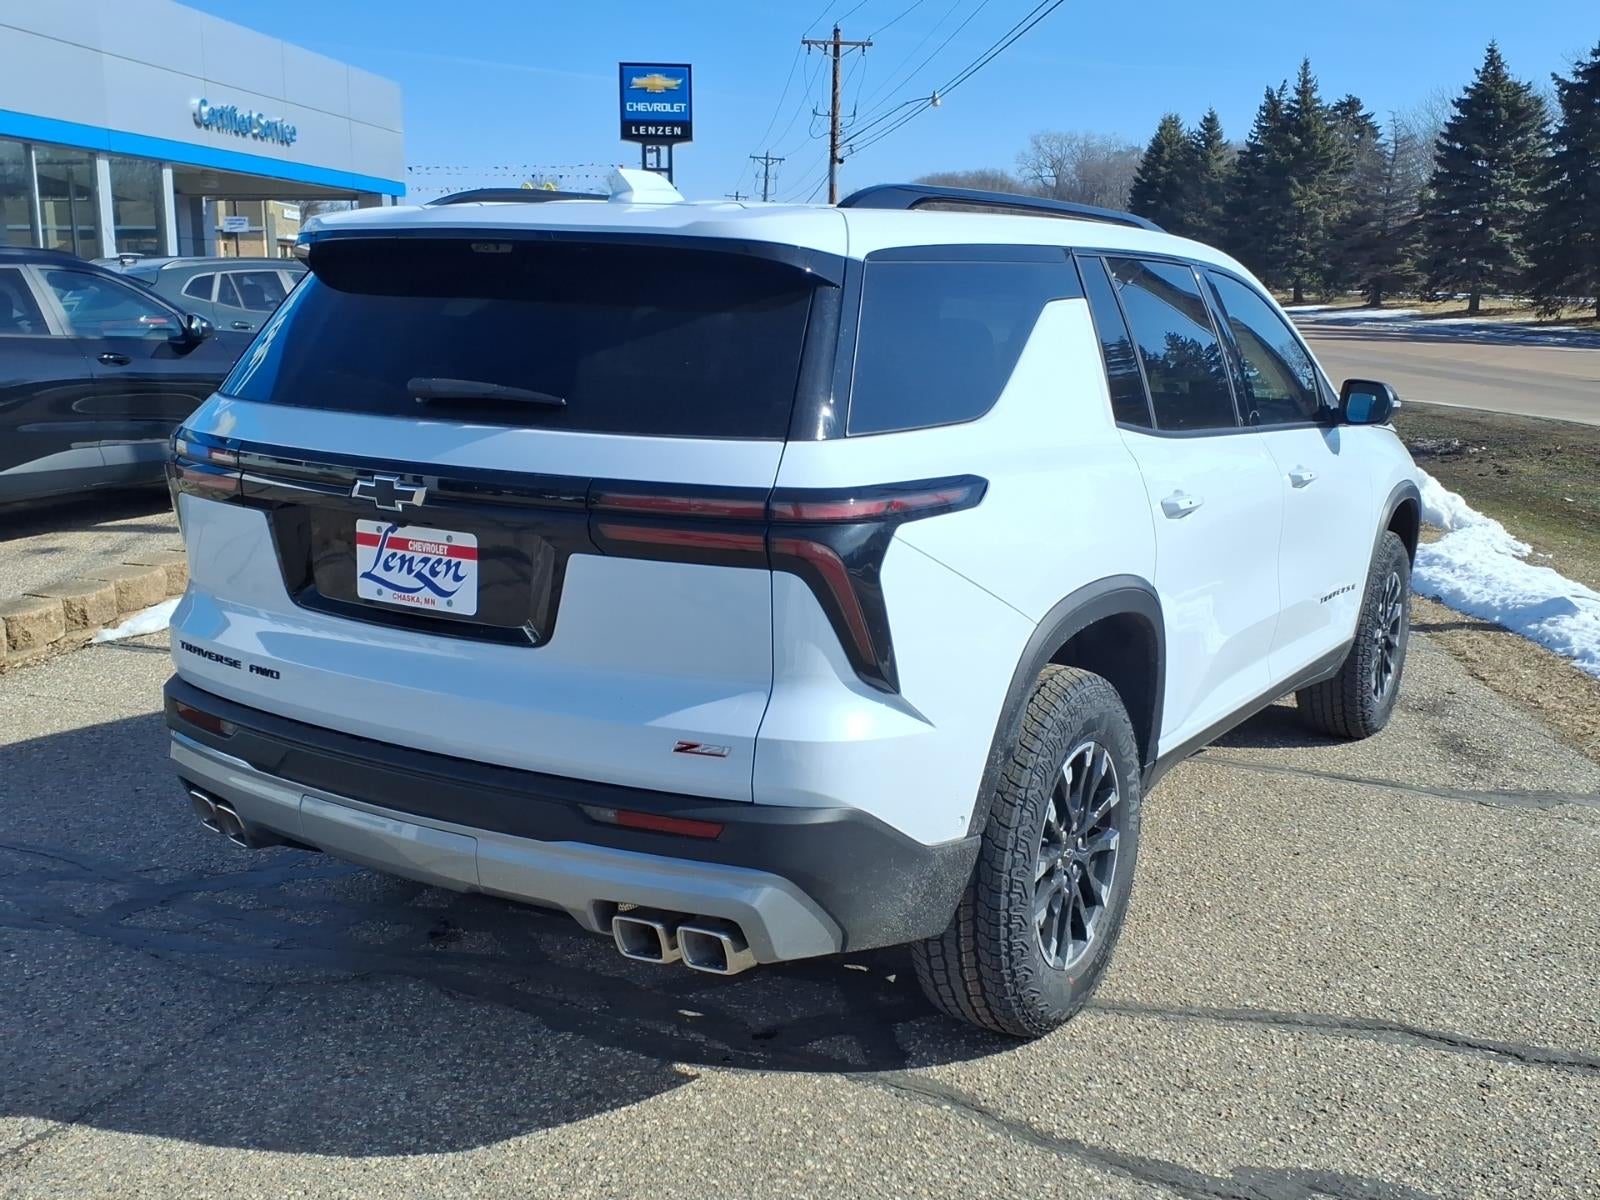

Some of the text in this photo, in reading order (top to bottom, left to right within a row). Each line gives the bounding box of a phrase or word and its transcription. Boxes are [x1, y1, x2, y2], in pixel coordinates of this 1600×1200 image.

[626, 102, 686, 112] CHEVROLET
[198, 98, 297, 144] Certified Service
[631, 125, 681, 135] LENZEN
[408, 540, 449, 555] CHEVROLET
[360, 523, 468, 598] Lenzen
[392, 592, 436, 606] CHASKA, MN
[179, 639, 280, 680] TRAVERSE AWD
[672, 740, 732, 757] Z71
